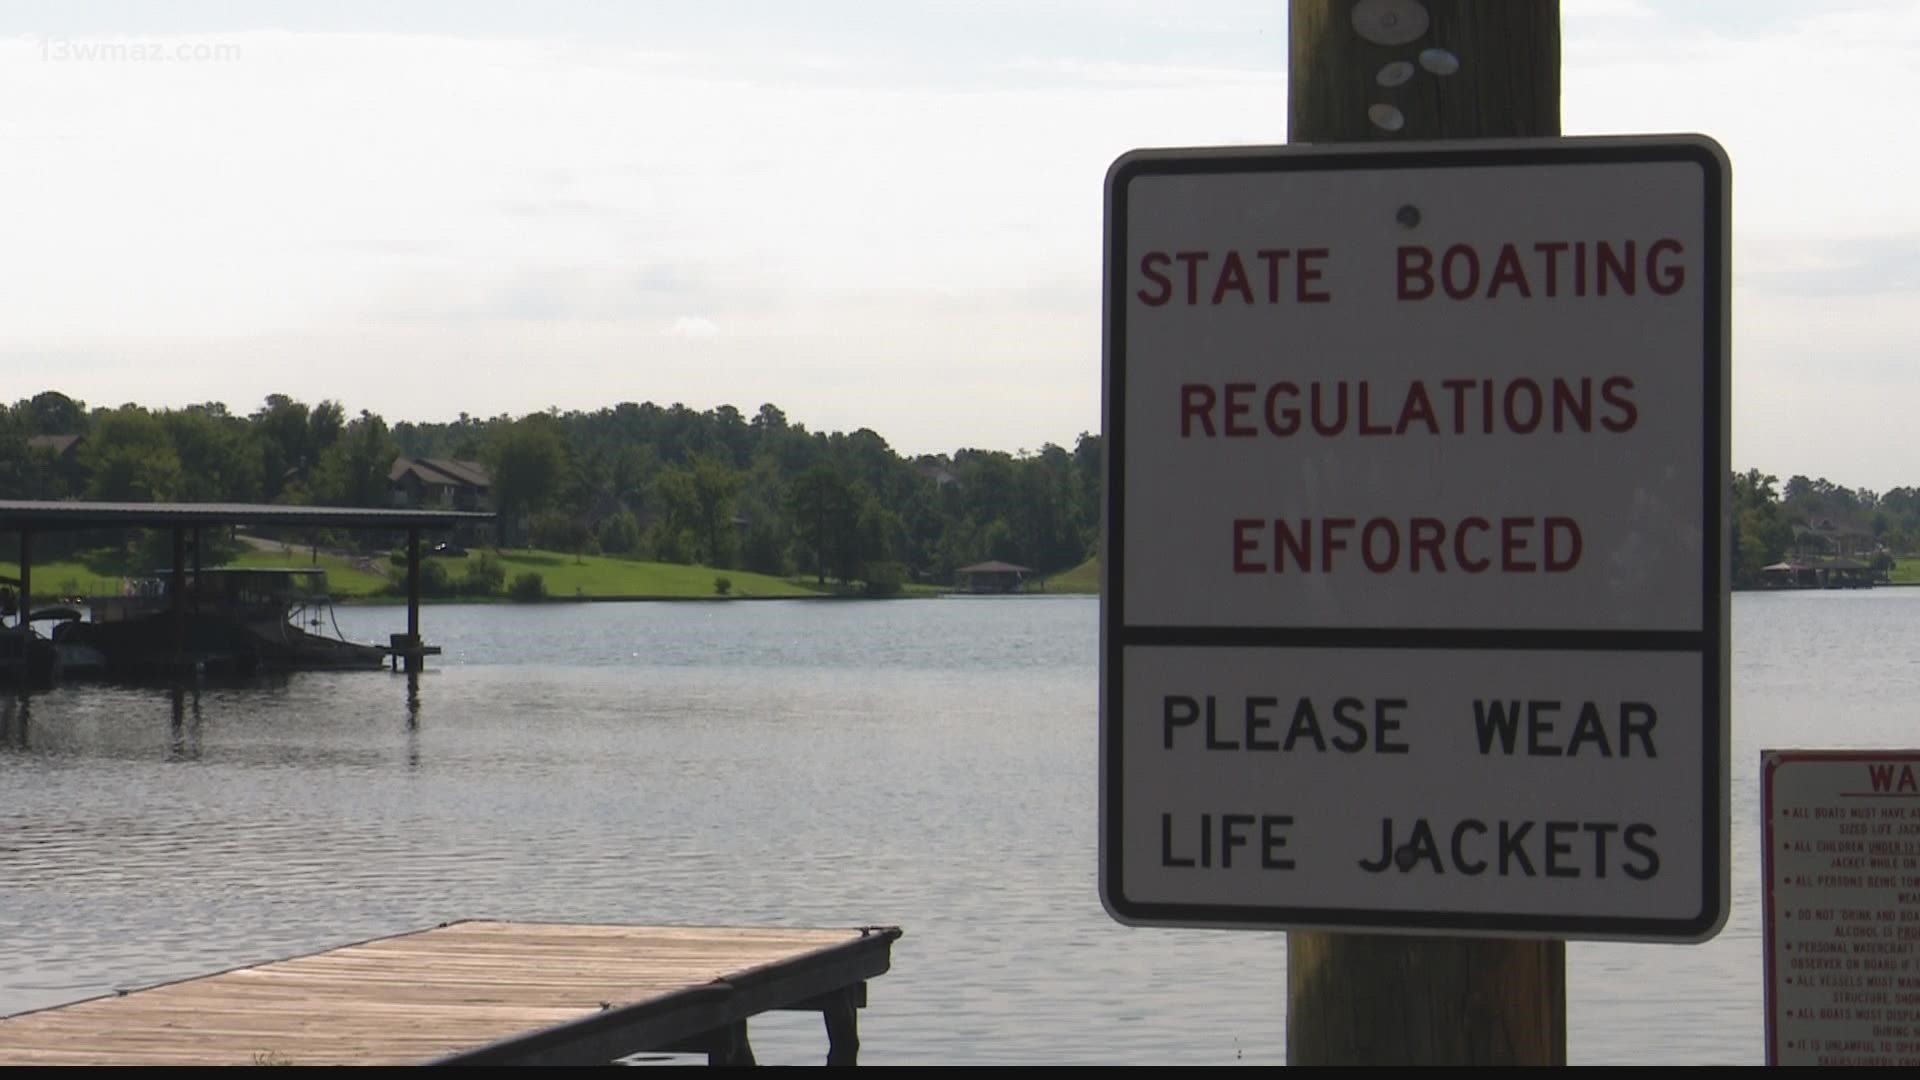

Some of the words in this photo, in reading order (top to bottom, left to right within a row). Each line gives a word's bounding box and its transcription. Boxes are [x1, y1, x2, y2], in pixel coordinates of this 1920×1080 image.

[1137, 248, 1331, 306] STATE
[1397, 238, 1686, 301] BOATING
[1180, 375, 1639, 438] REGULATIONS
[1232, 516, 1583, 574] ENFORCED
[1162, 695, 1410, 754] PLEASE
[1473, 700, 1659, 758] WEAR
[1792, 807, 1809, 818] ALL
[1815, 807, 1846, 818] BOATS
[1850, 807, 1876, 818] MUST
[1881, 807, 1905, 818] HAVE
[1161, 813, 1296, 871] LIFE
[1358, 817, 1661, 880] JACKETS
[1794, 840, 1811, 853] ALL
[1816, 840, 1864, 853] CHILDREN
[1796, 875, 1813, 888] ALL
[1818, 875, 1863, 888] PERSONS
[1798, 908, 1811, 921] DO
[1815, 908, 1834, 921] NOT
[1876, 908, 1895, 921] AND
[1834, 926, 1877, 938] ALCOHOL
[1798, 941, 1847, 954] PERSONAL
[1853, 941, 1914, 954] WATERCRAFT
[1791, 957, 1841, 970] OBSERVER
[1797, 976, 1814, 988] ALL
[1820, 976, 1863, 988] VESSELS
[1798, 1008, 1815, 1021] ALL
[1820, 1008, 1851, 1021] BOATS
